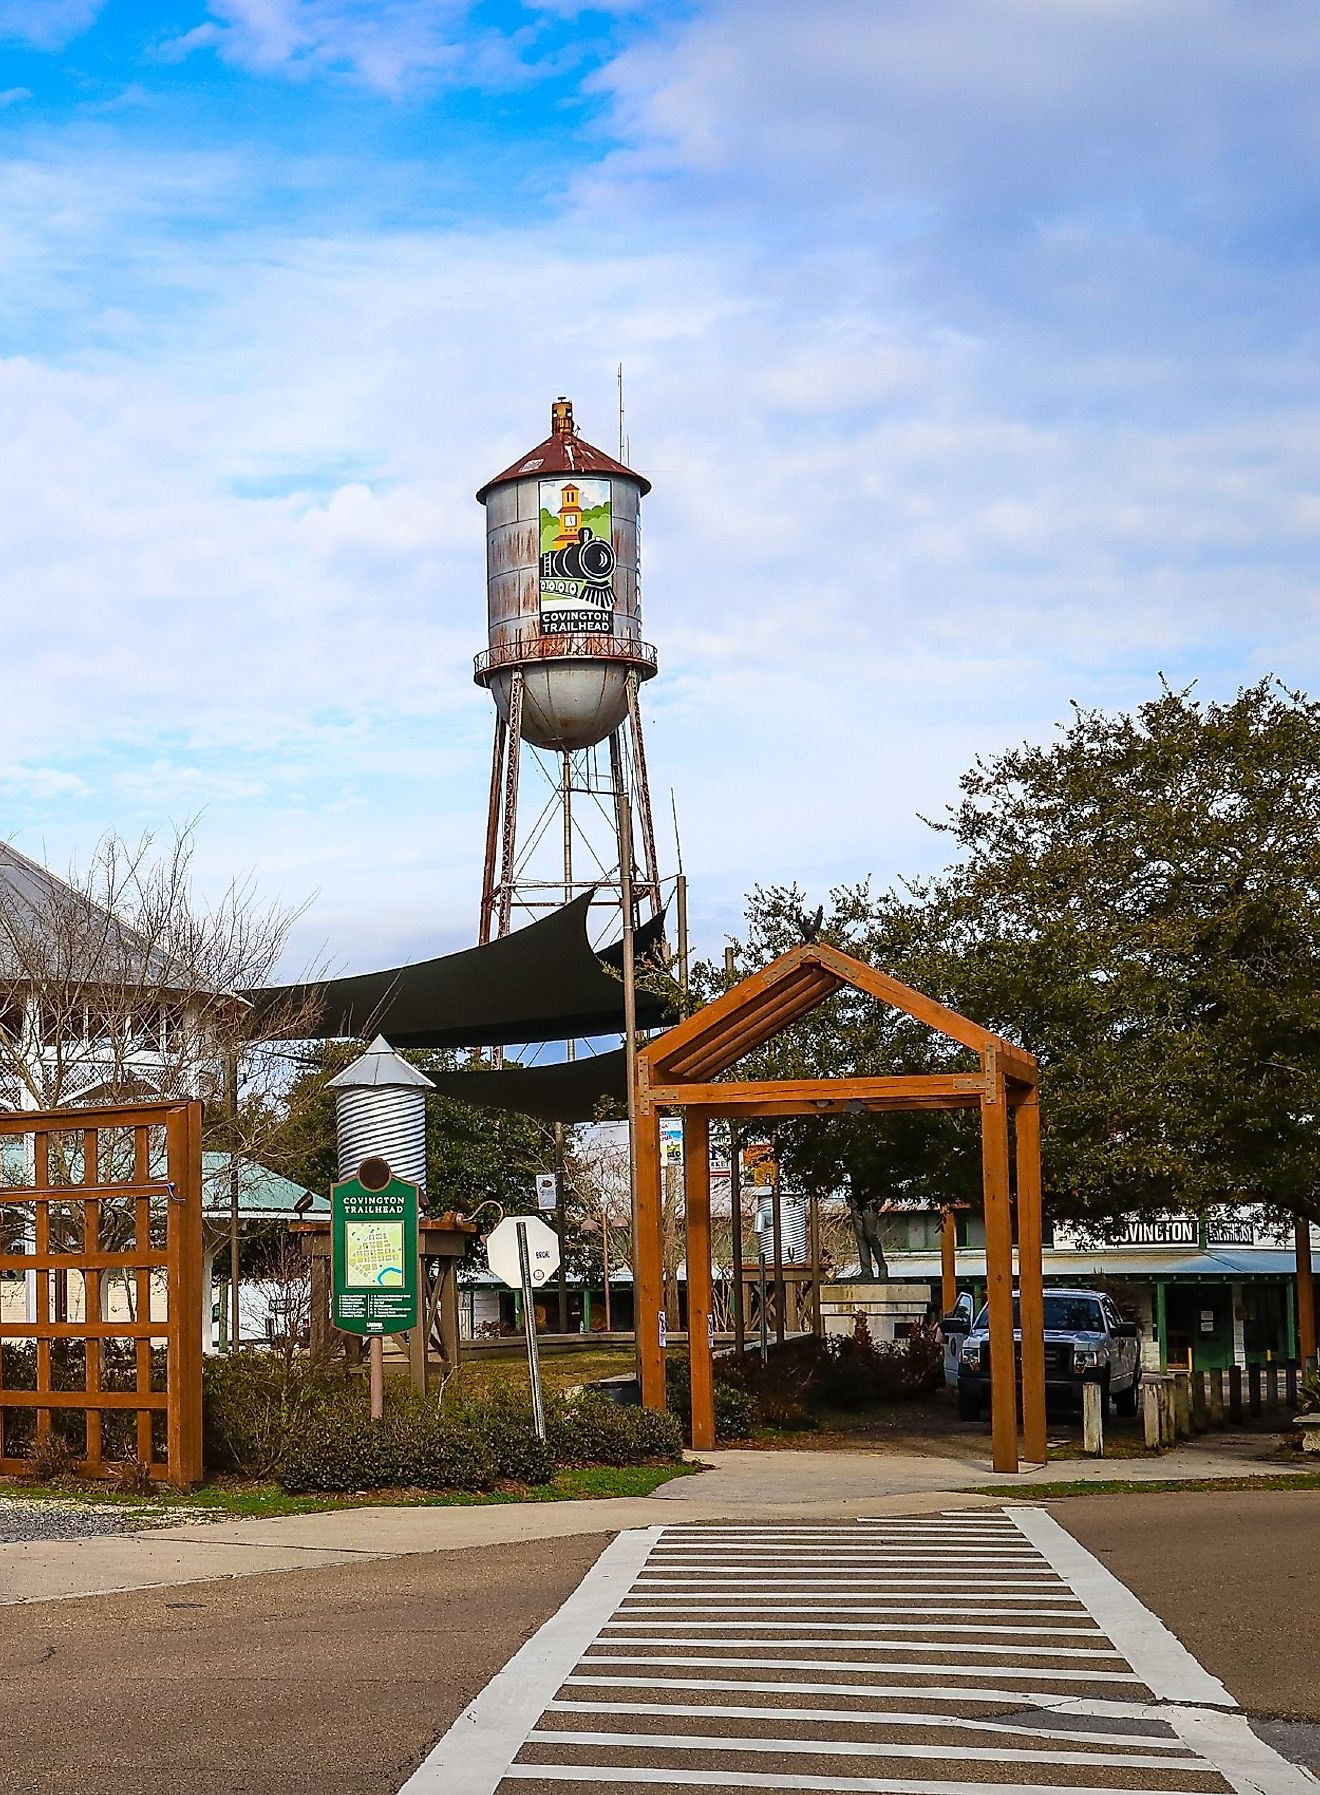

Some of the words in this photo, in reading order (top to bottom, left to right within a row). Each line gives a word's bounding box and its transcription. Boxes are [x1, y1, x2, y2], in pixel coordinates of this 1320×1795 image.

[542, 611, 609, 622] COVINGTON
[542, 621, 610, 633] TRAILHEAD
[342, 1196, 405, 1205] COVINGTON
[344, 1205, 404, 1214] TRAILHEAD
